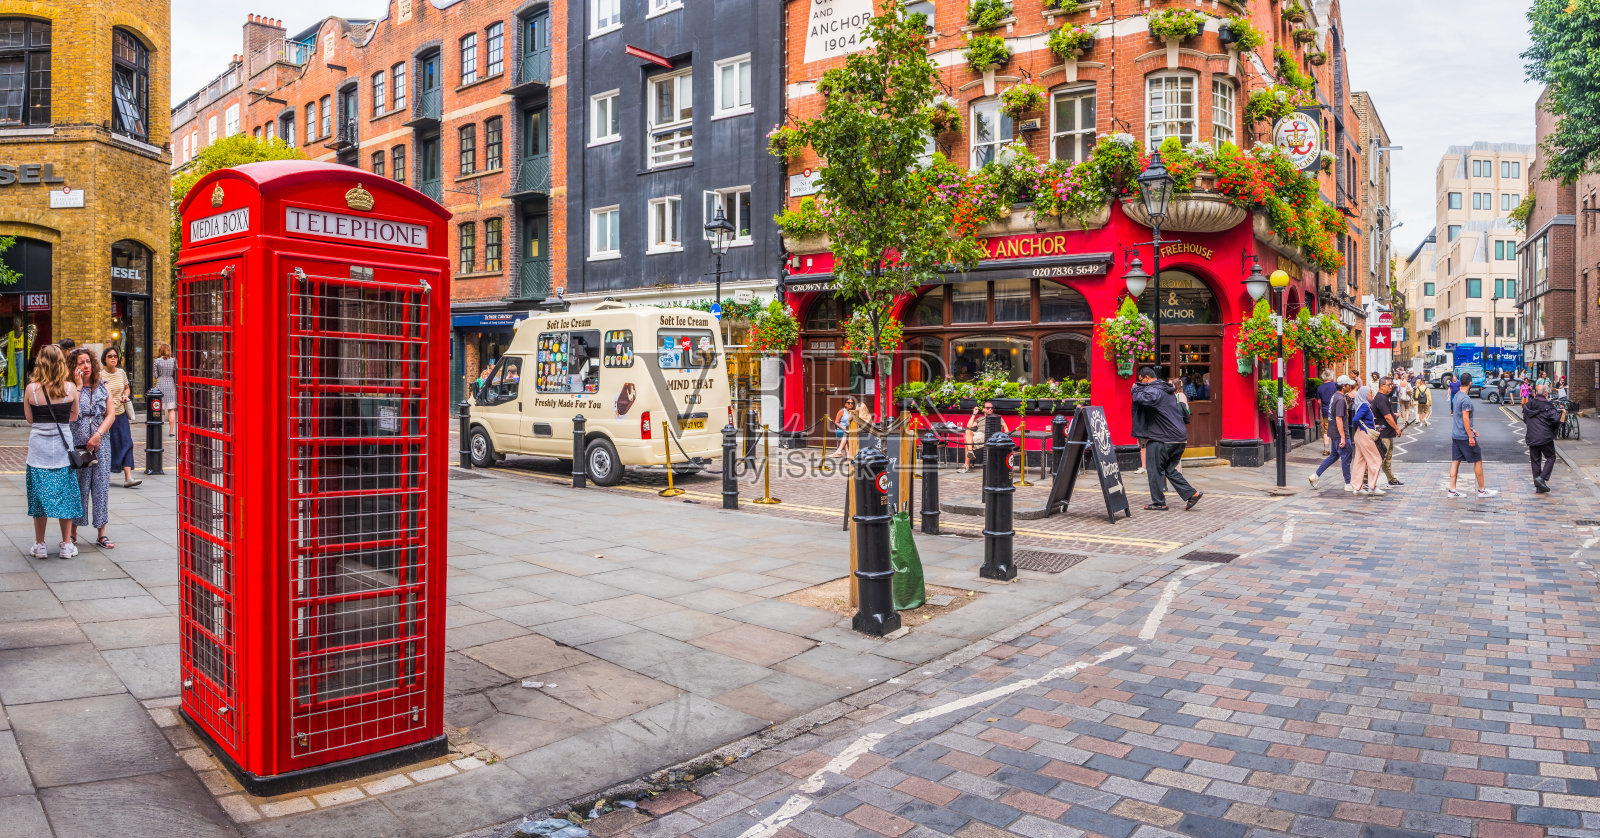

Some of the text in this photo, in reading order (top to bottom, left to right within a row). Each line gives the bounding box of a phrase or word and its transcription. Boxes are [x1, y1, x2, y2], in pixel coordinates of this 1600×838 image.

[813, 7, 833, 20] AND
[811, 12, 871, 37] ANCHOR
[825, 34, 856, 51] 1904
[192, 207, 249, 241] MEDIA BOXX
[290, 210, 422, 246] TELEPHONE
[979, 235, 1066, 258] & ANCHOR
[1160, 243, 1214, 260] FREEHOUSE
[111, 266, 141, 280] IESEL
[1032, 264, 1099, 277] 020 7836 5649
[792, 283, 822, 292] CROWN
[822, 282, 831, 290] &
[1160, 279, 1193, 289] ROWN
[1168, 291, 1179, 306] &
[1153, 309, 1195, 319] NCHOR
[546, 318, 592, 330] Soft Ice Cream
[659, 315, 709, 327] Soft Ice Cream
[666, 378, 714, 391] MIND THAT
[535, 398, 602, 409] Freshly Made For You
[684, 394, 702, 405] CHILD
